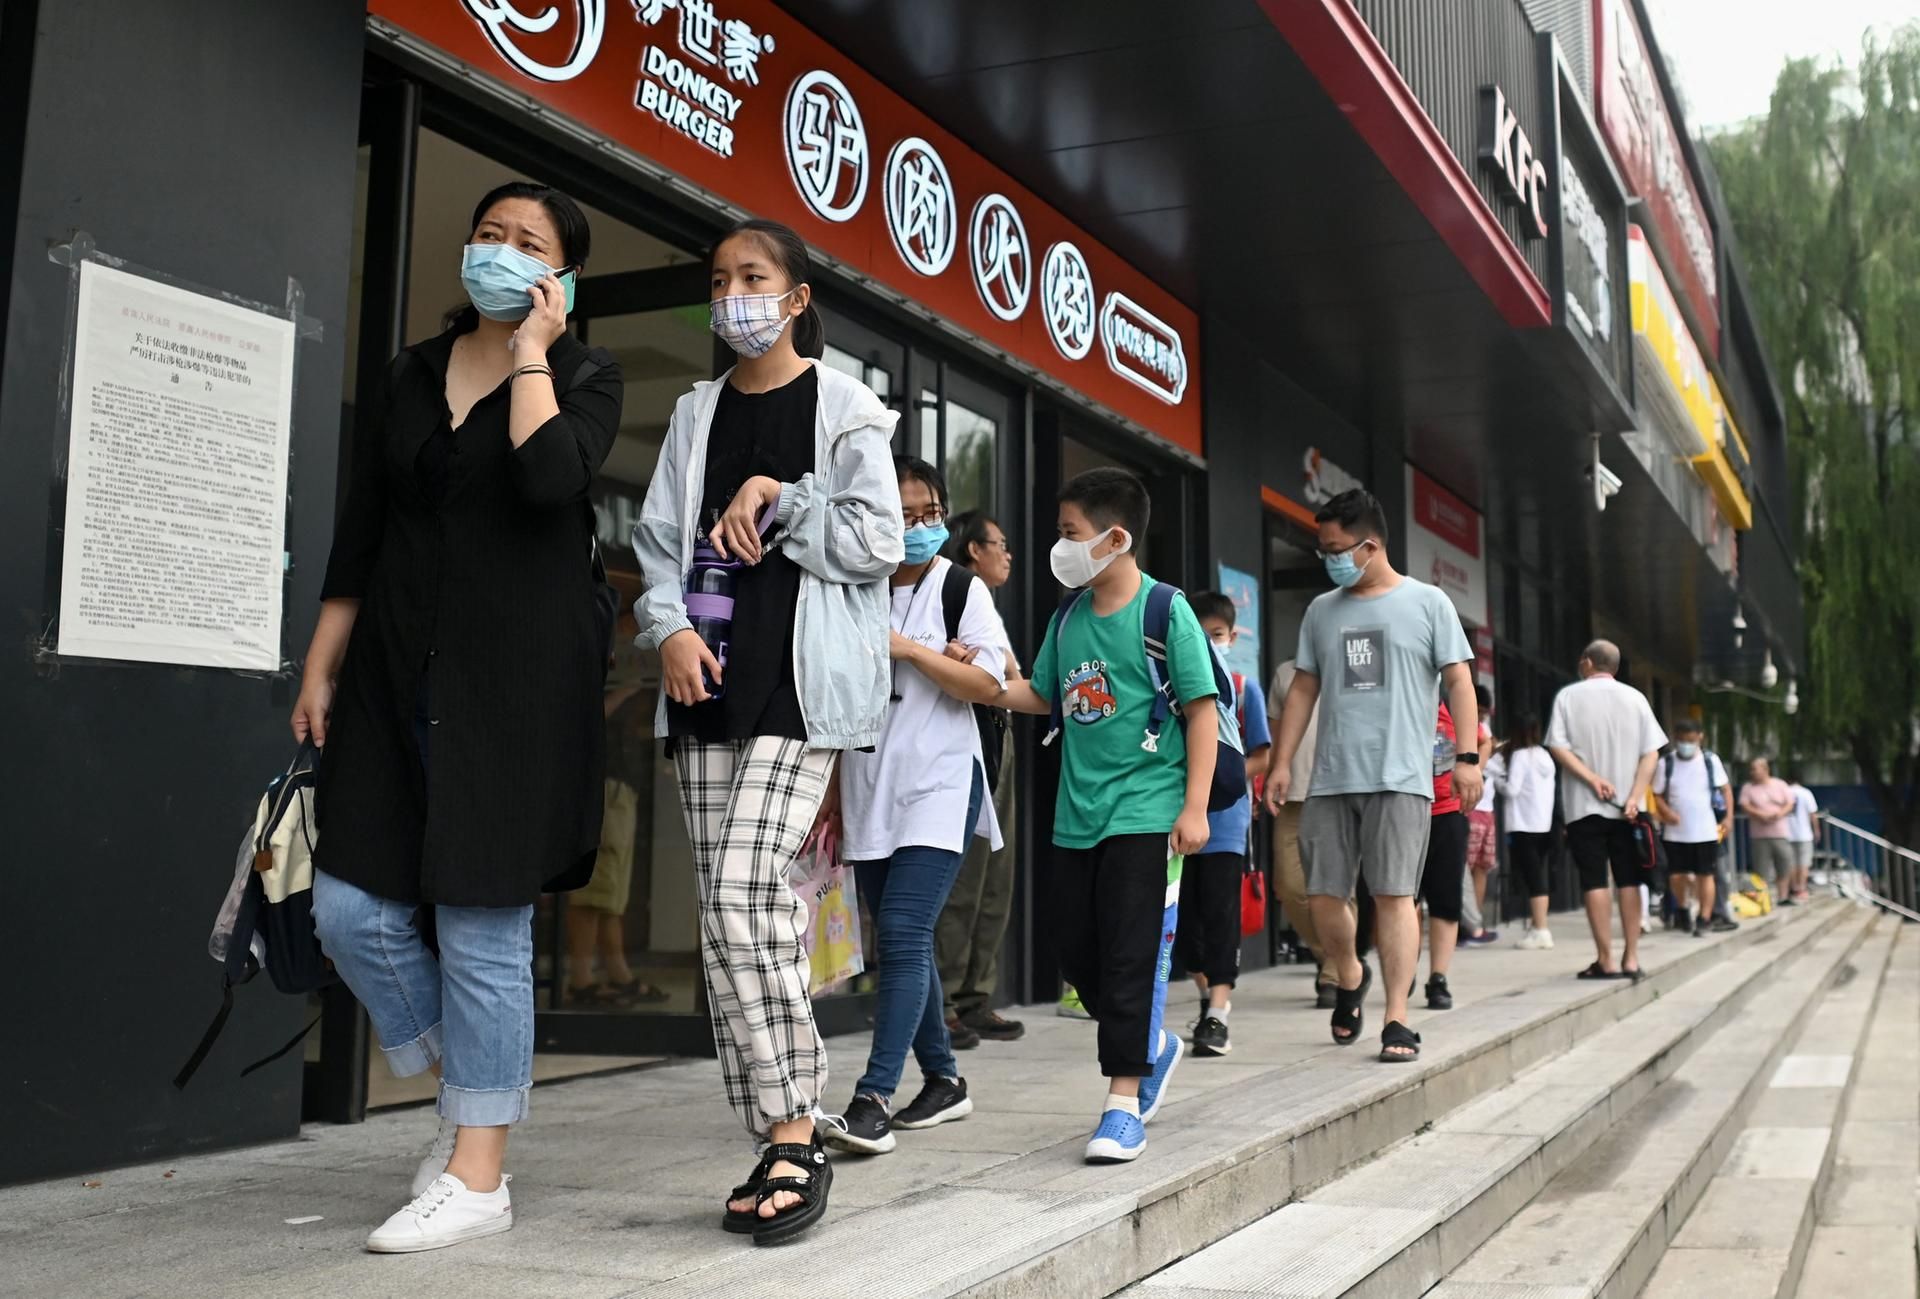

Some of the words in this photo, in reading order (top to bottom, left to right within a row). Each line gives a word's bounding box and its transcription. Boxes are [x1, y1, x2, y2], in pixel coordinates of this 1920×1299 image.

[638, 79, 734, 156] BURGER
[645, 45, 742, 121] DONKEY
[1494, 84, 1548, 238] KFC
[1346, 638, 1370, 654] LIVE
[1347, 652, 1373, 667] TEXT
